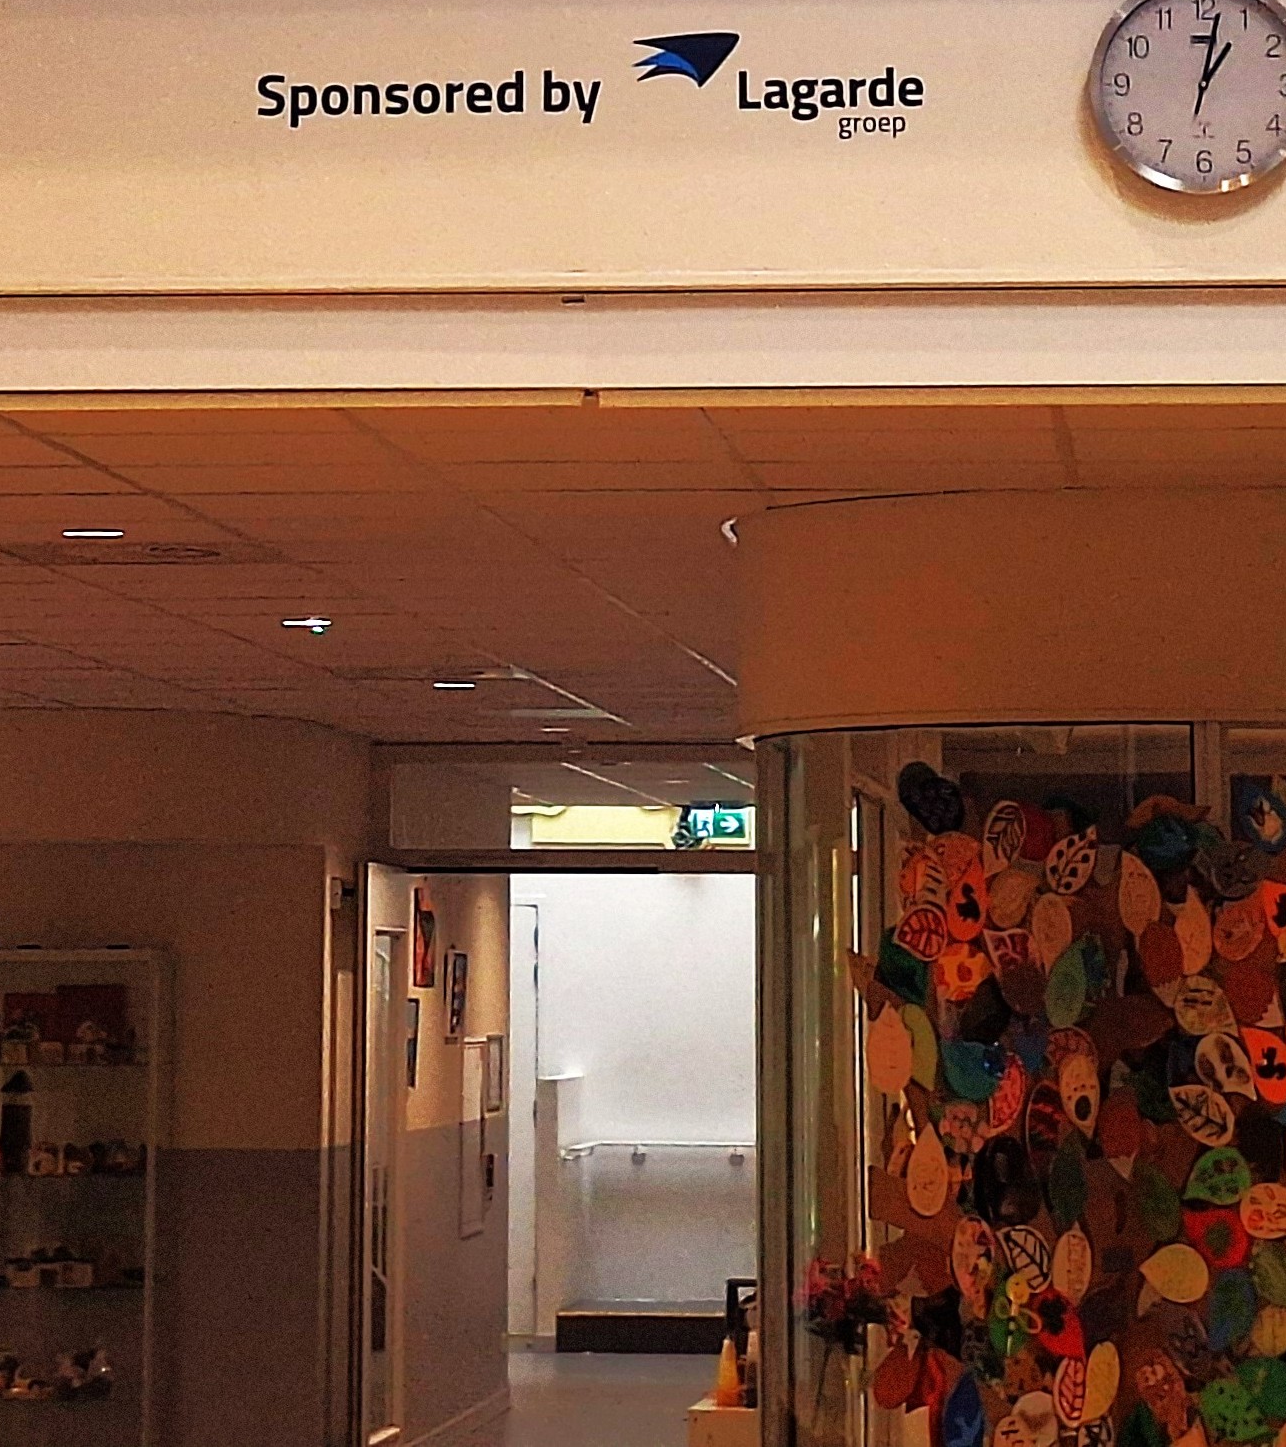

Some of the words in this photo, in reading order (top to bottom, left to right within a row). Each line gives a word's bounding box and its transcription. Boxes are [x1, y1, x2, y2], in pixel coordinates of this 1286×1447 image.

[1155, 9, 1173, 31] 11
[1239, 9, 1248, 31] 1
[1126, 35, 1150, 60] 10
[1265, 34, 1282, 58] 2
[256, 70, 525, 127] Sponsored
[543, 69, 601, 124] by
[737, 67, 925, 121] Lagarde
[1113, 72, 1131, 97] 9
[838, 114, 906, 140] groep
[1126, 112, 1144, 137] 8
[1265, 113, 1283, 137] 4
[1157, 139, 1173, 164] 7
[1195, 149, 1213, 174] 6
[1236, 139, 1252, 164] 5
